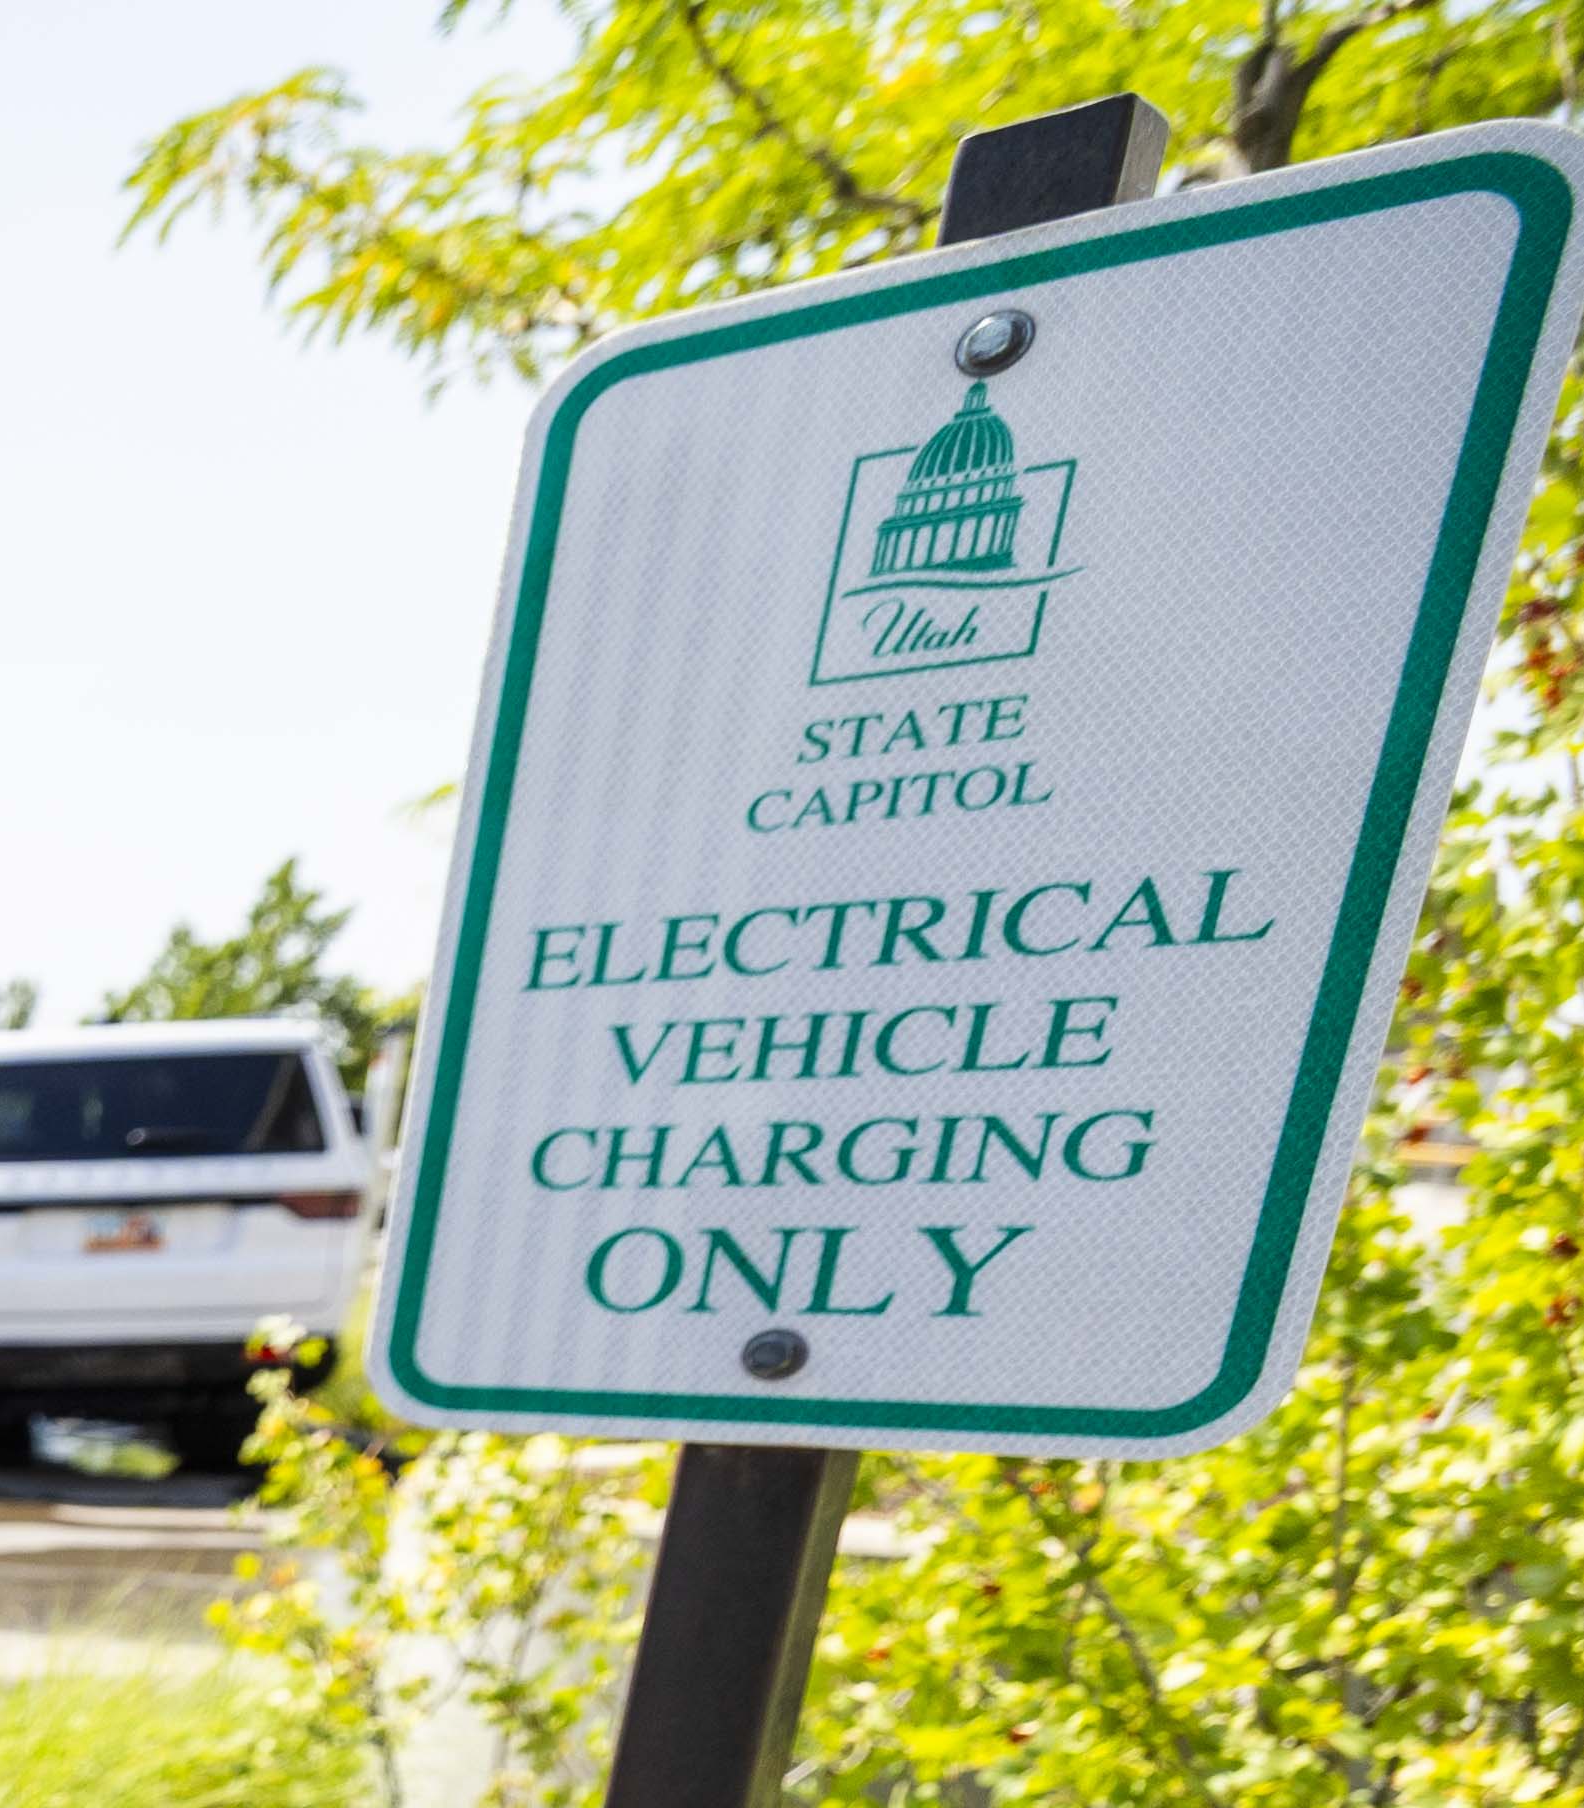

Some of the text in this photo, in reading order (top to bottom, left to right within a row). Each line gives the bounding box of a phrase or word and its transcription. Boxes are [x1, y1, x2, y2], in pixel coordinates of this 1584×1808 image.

[860, 600, 980, 660] Utah
[796, 693, 1028, 764] STATE
[745, 759, 1055, 835] CAPITOL
[523, 868, 1275, 993] ELECTRICAL
[608, 994, 1120, 1087] VEHICLE
[528, 1107, 1156, 1192] CHARGING
[583, 1223, 1035, 1319] ONLY
